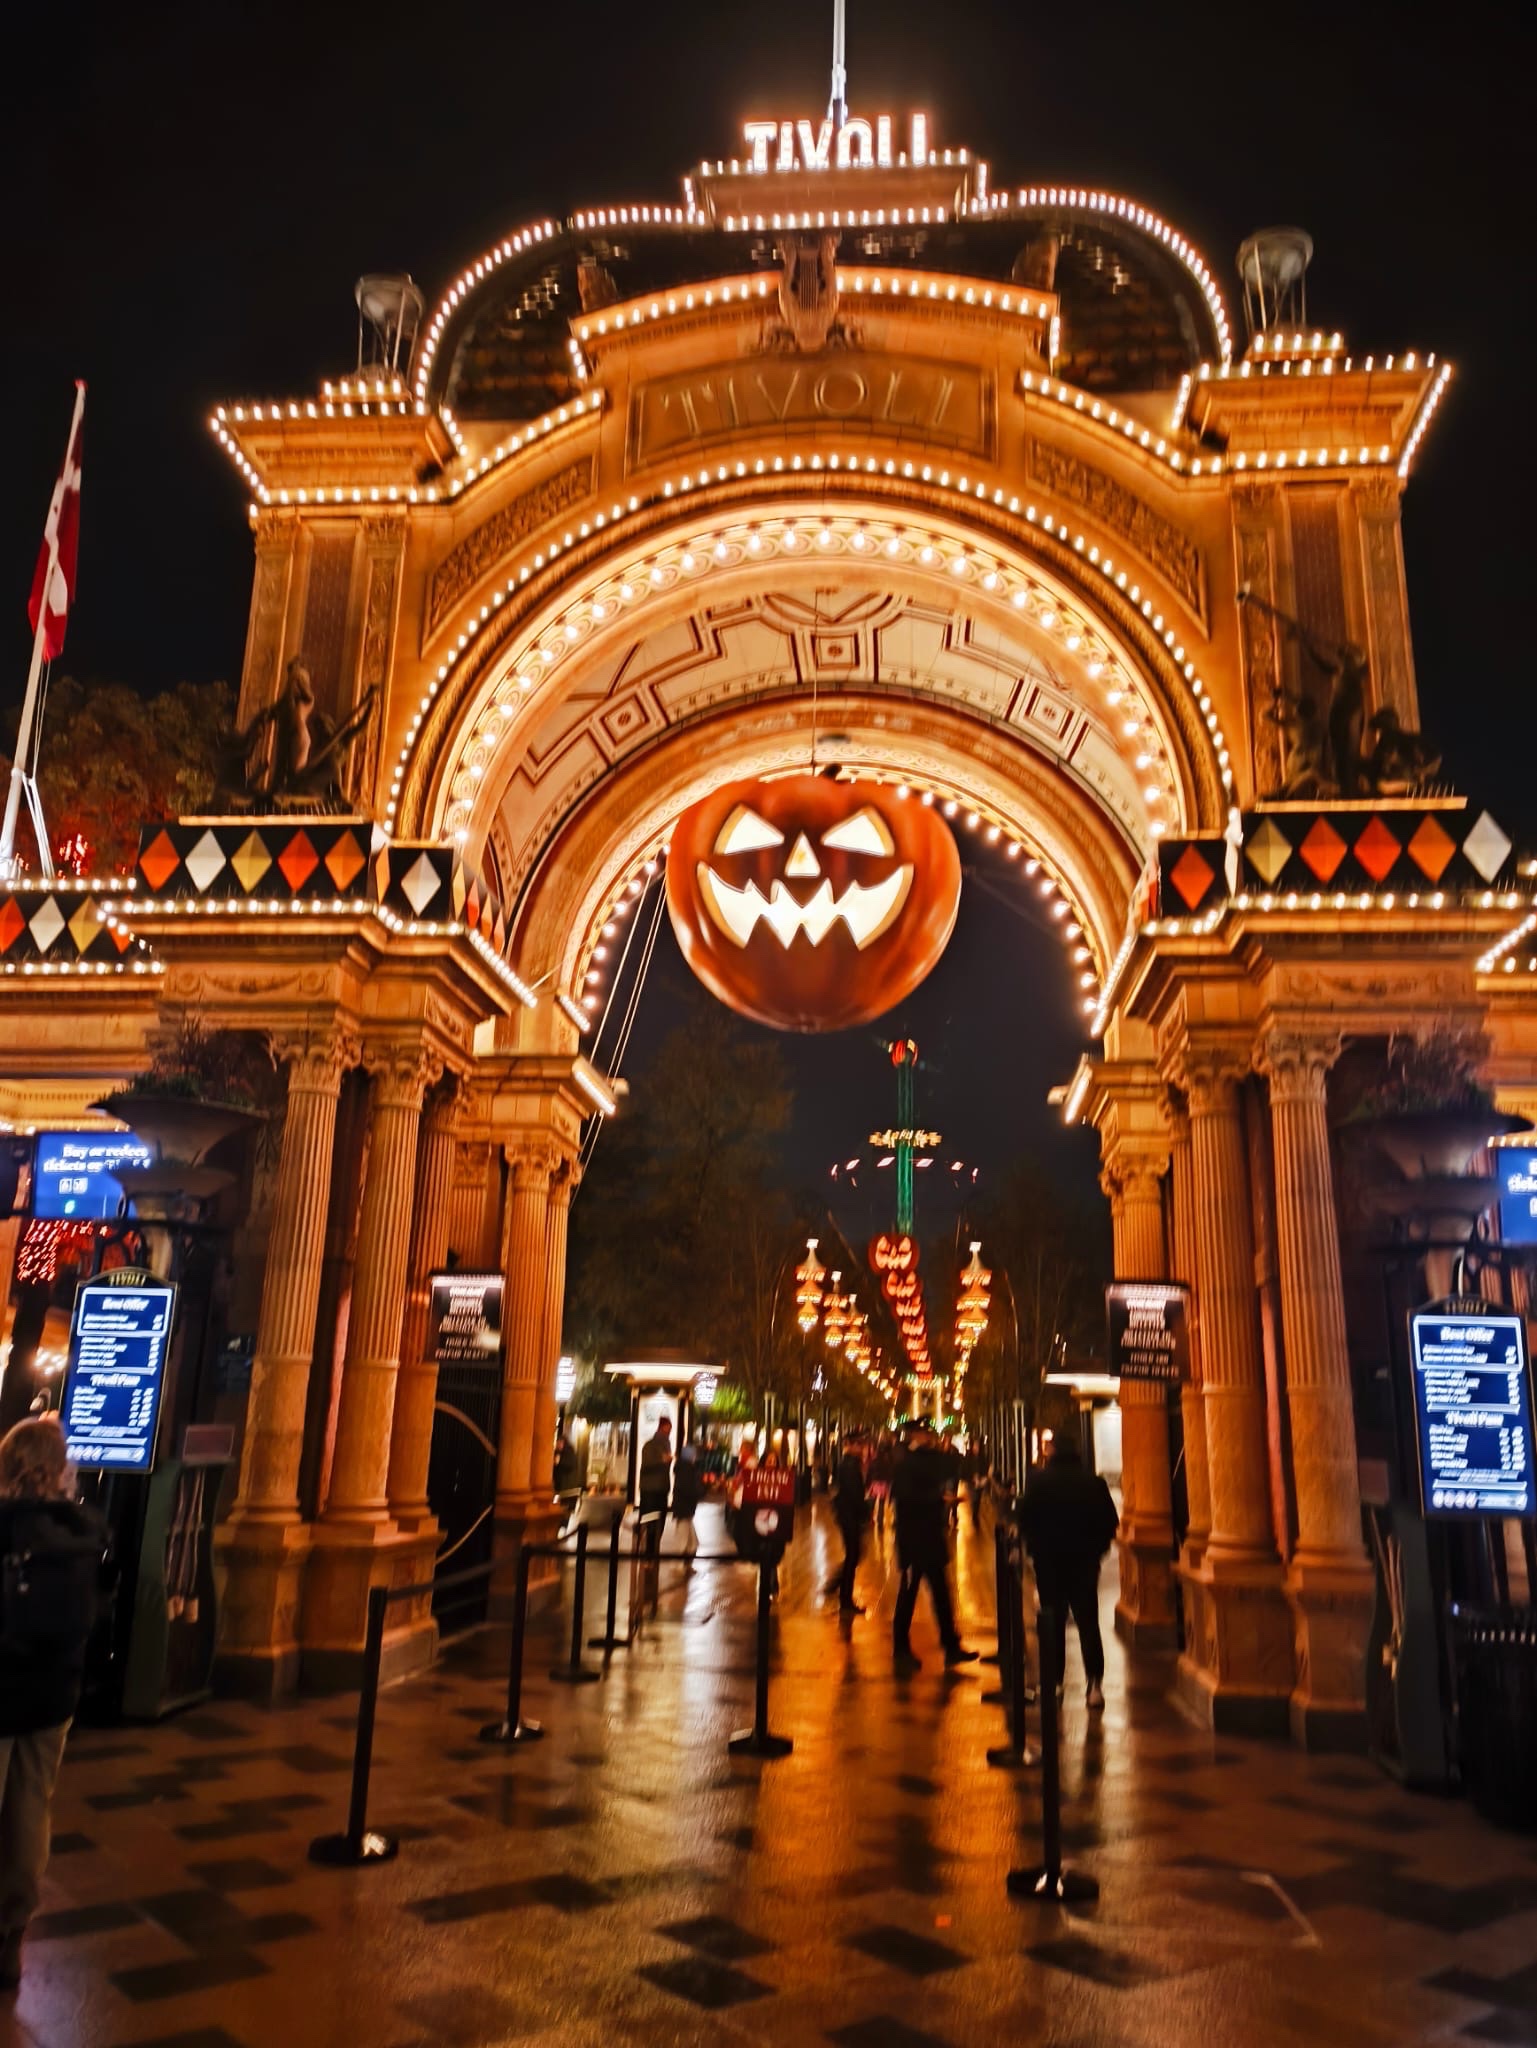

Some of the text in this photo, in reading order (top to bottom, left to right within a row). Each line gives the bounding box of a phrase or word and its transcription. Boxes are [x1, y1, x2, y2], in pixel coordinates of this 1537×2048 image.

[744, 113, 926, 172] TIVOLI
[660, 369, 953, 438] TIVOLI
[108, 1271, 147, 1287] TIVOLI
